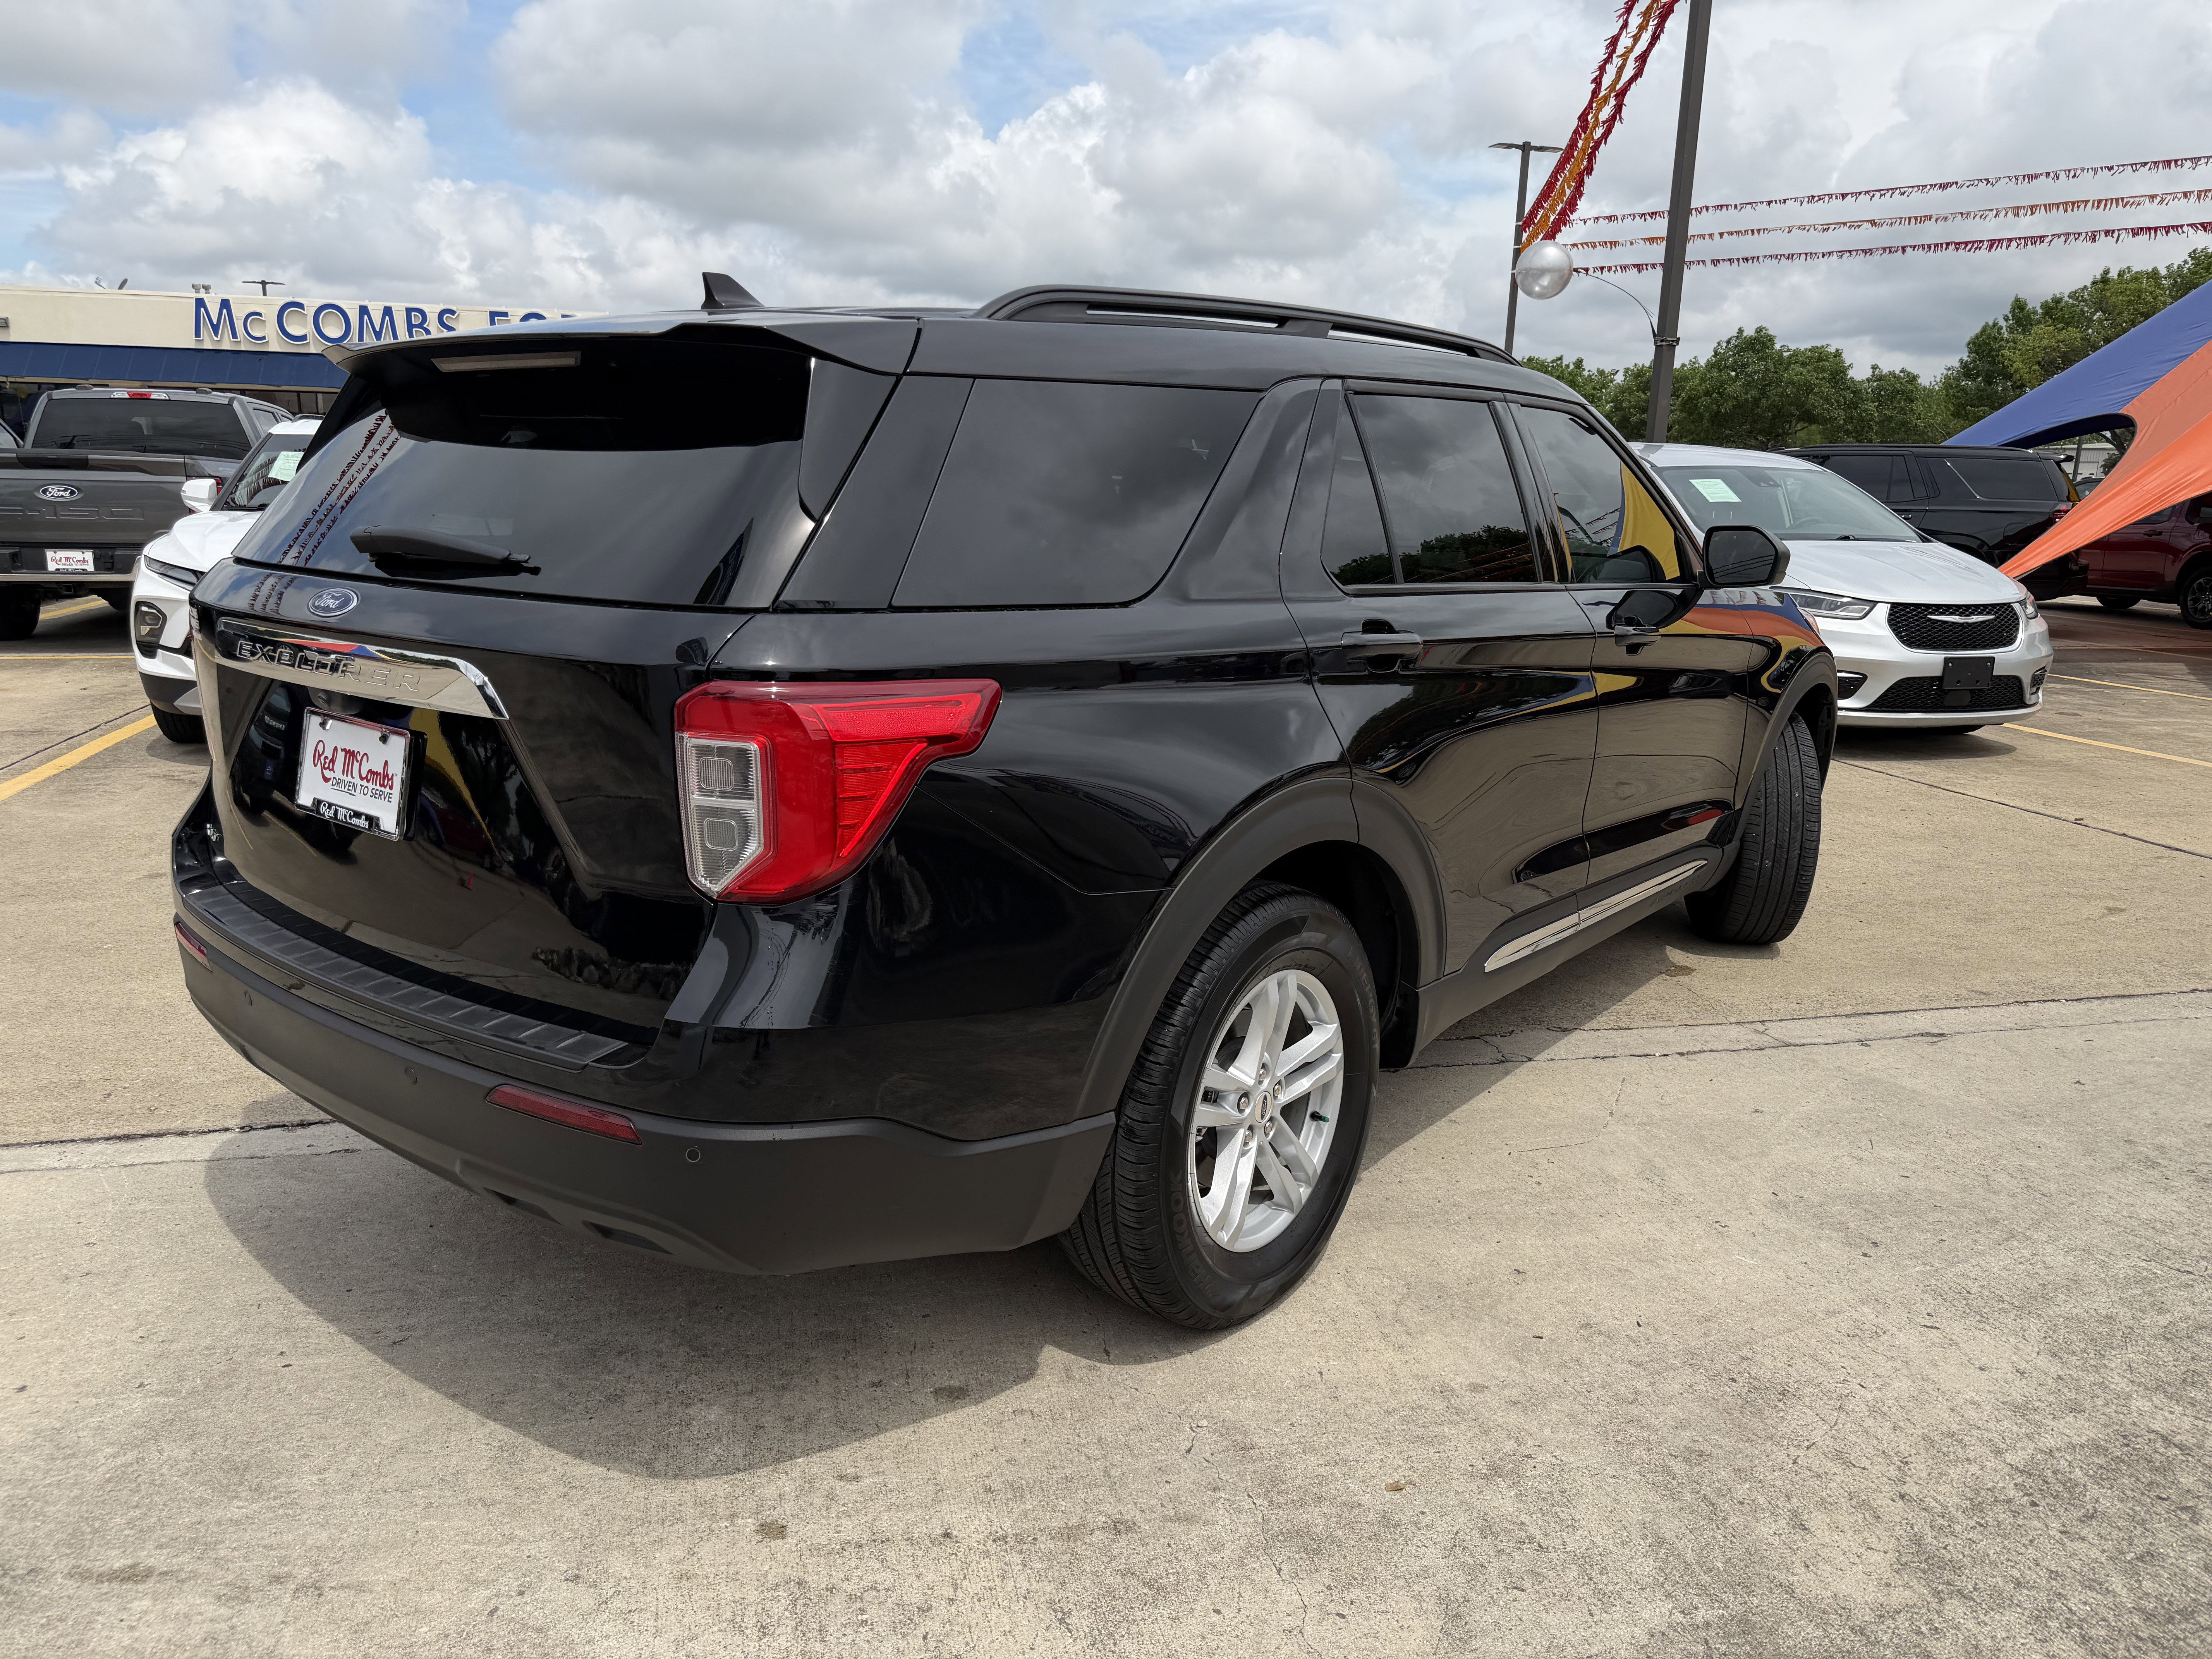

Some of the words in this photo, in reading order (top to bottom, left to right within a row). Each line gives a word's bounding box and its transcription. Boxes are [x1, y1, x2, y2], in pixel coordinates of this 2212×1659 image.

[46, 487, 70, 497] Ford
[51, 556, 62, 565] Red
[315, 591, 345, 609] Ford
[237, 640, 421, 692] EXPLORER
[313, 739, 338, 783] Red
[340, 746, 394, 791] McCombs
[331, 776, 358, 793] DRIVEN
[359, 784, 369, 796] TO
[370, 788, 393, 803] SERVE
[320, 802, 335, 818] Red
[336, 806, 369, 829] McCombs
